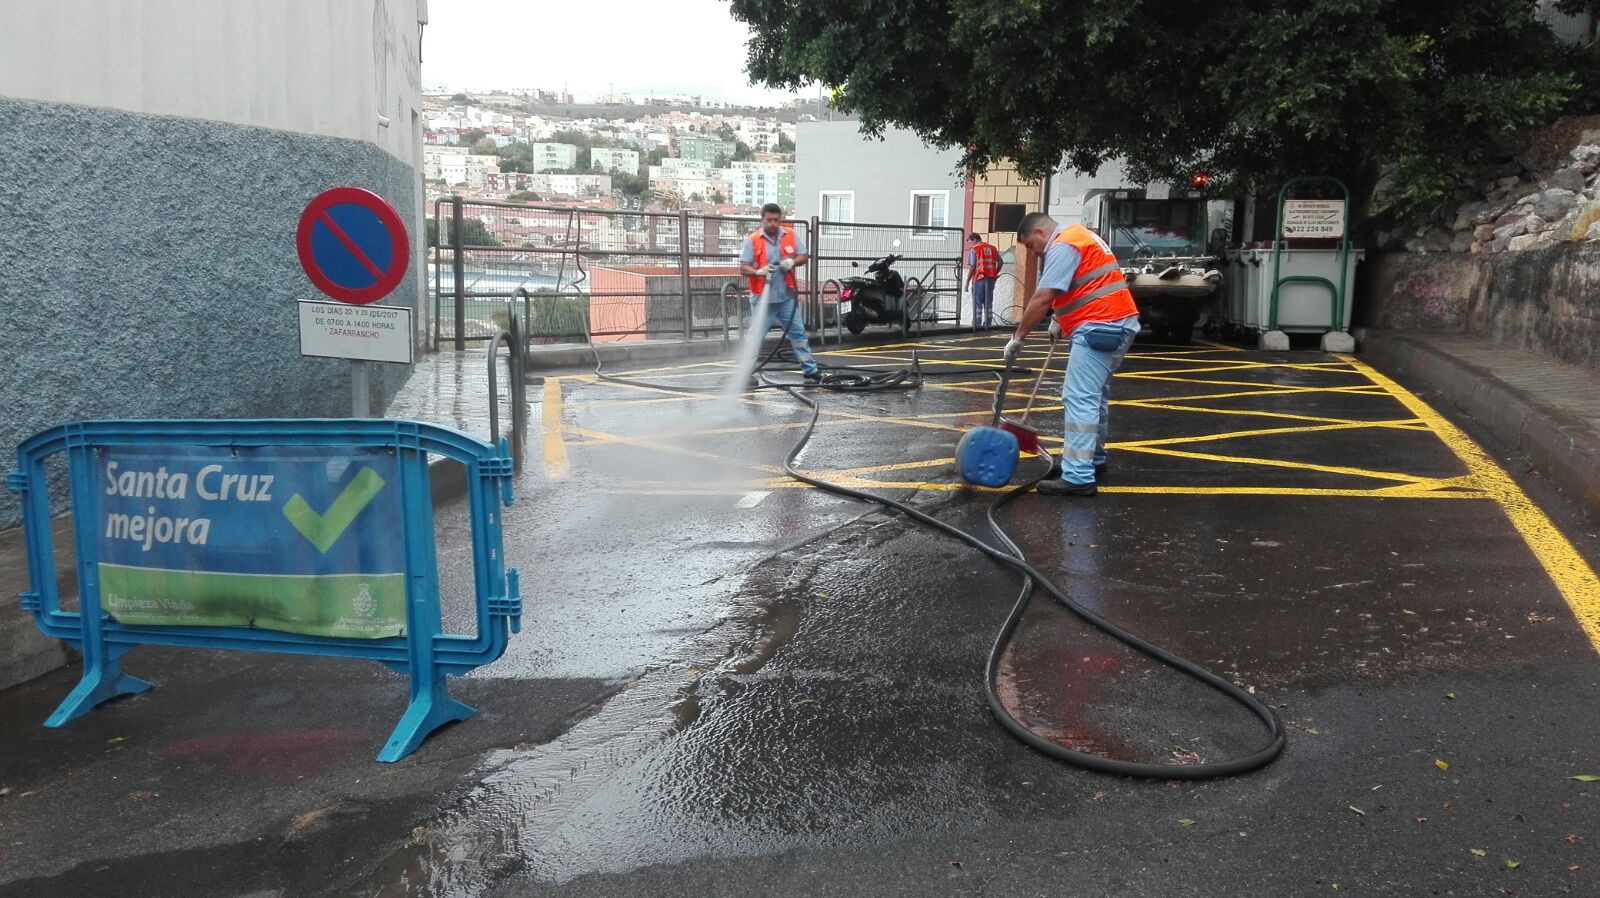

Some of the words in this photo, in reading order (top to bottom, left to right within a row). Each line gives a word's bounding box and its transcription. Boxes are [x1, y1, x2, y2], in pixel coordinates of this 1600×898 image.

[311, 306, 325, 314] LOS
[315, 317, 324, 325] DE
[372, 322, 395, 330] HORAS
[105, 461, 189, 499] Santa
[195, 464, 275, 502] Cruz
[105, 506, 211, 552] mejora
